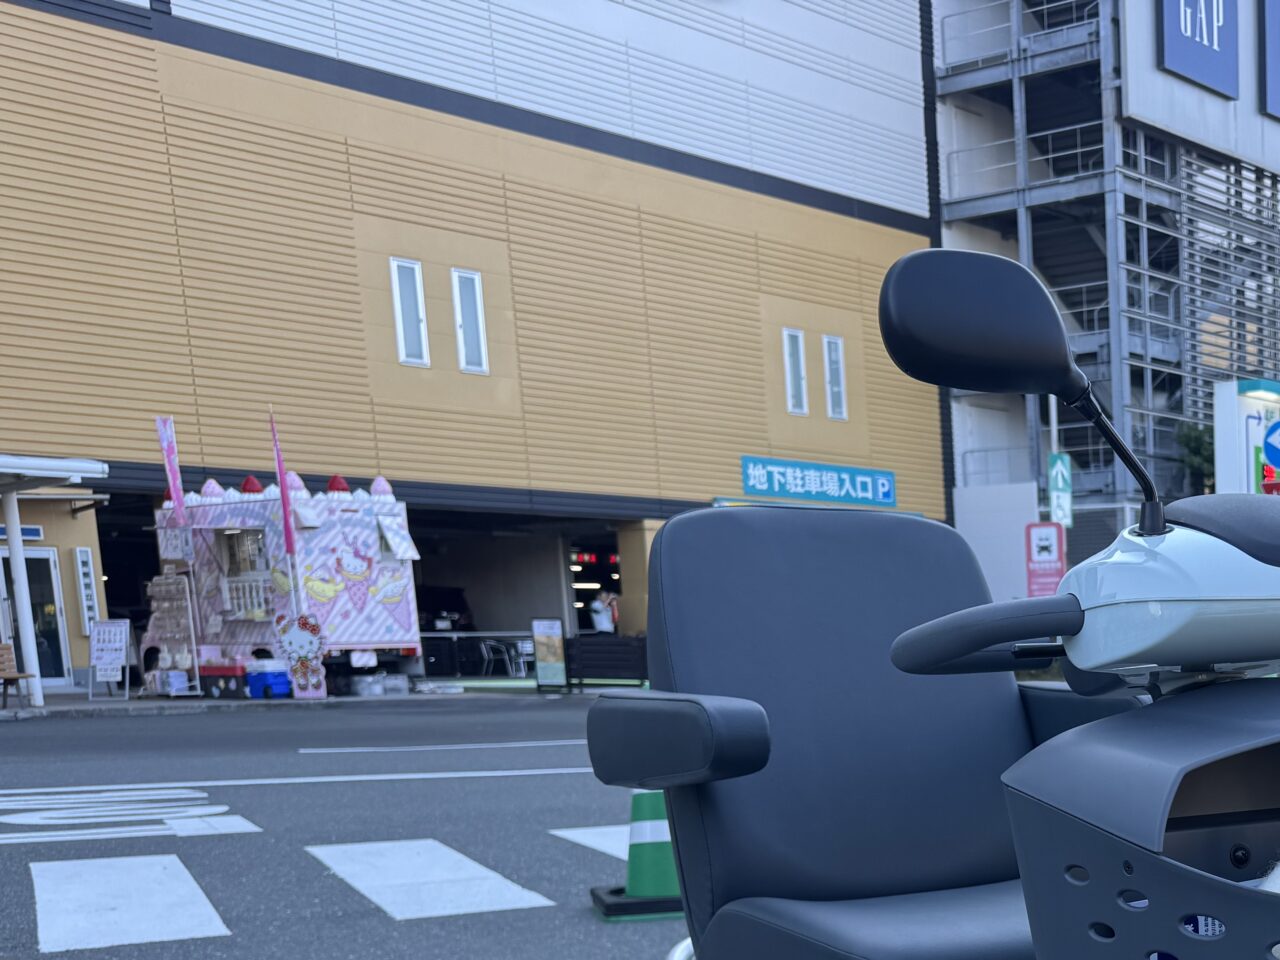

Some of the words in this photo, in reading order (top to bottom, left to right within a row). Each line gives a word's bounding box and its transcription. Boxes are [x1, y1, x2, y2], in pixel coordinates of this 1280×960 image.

[1179, 0, 1224, 51] GAP
[747, 463, 873, 500] 地下駐車場入口
